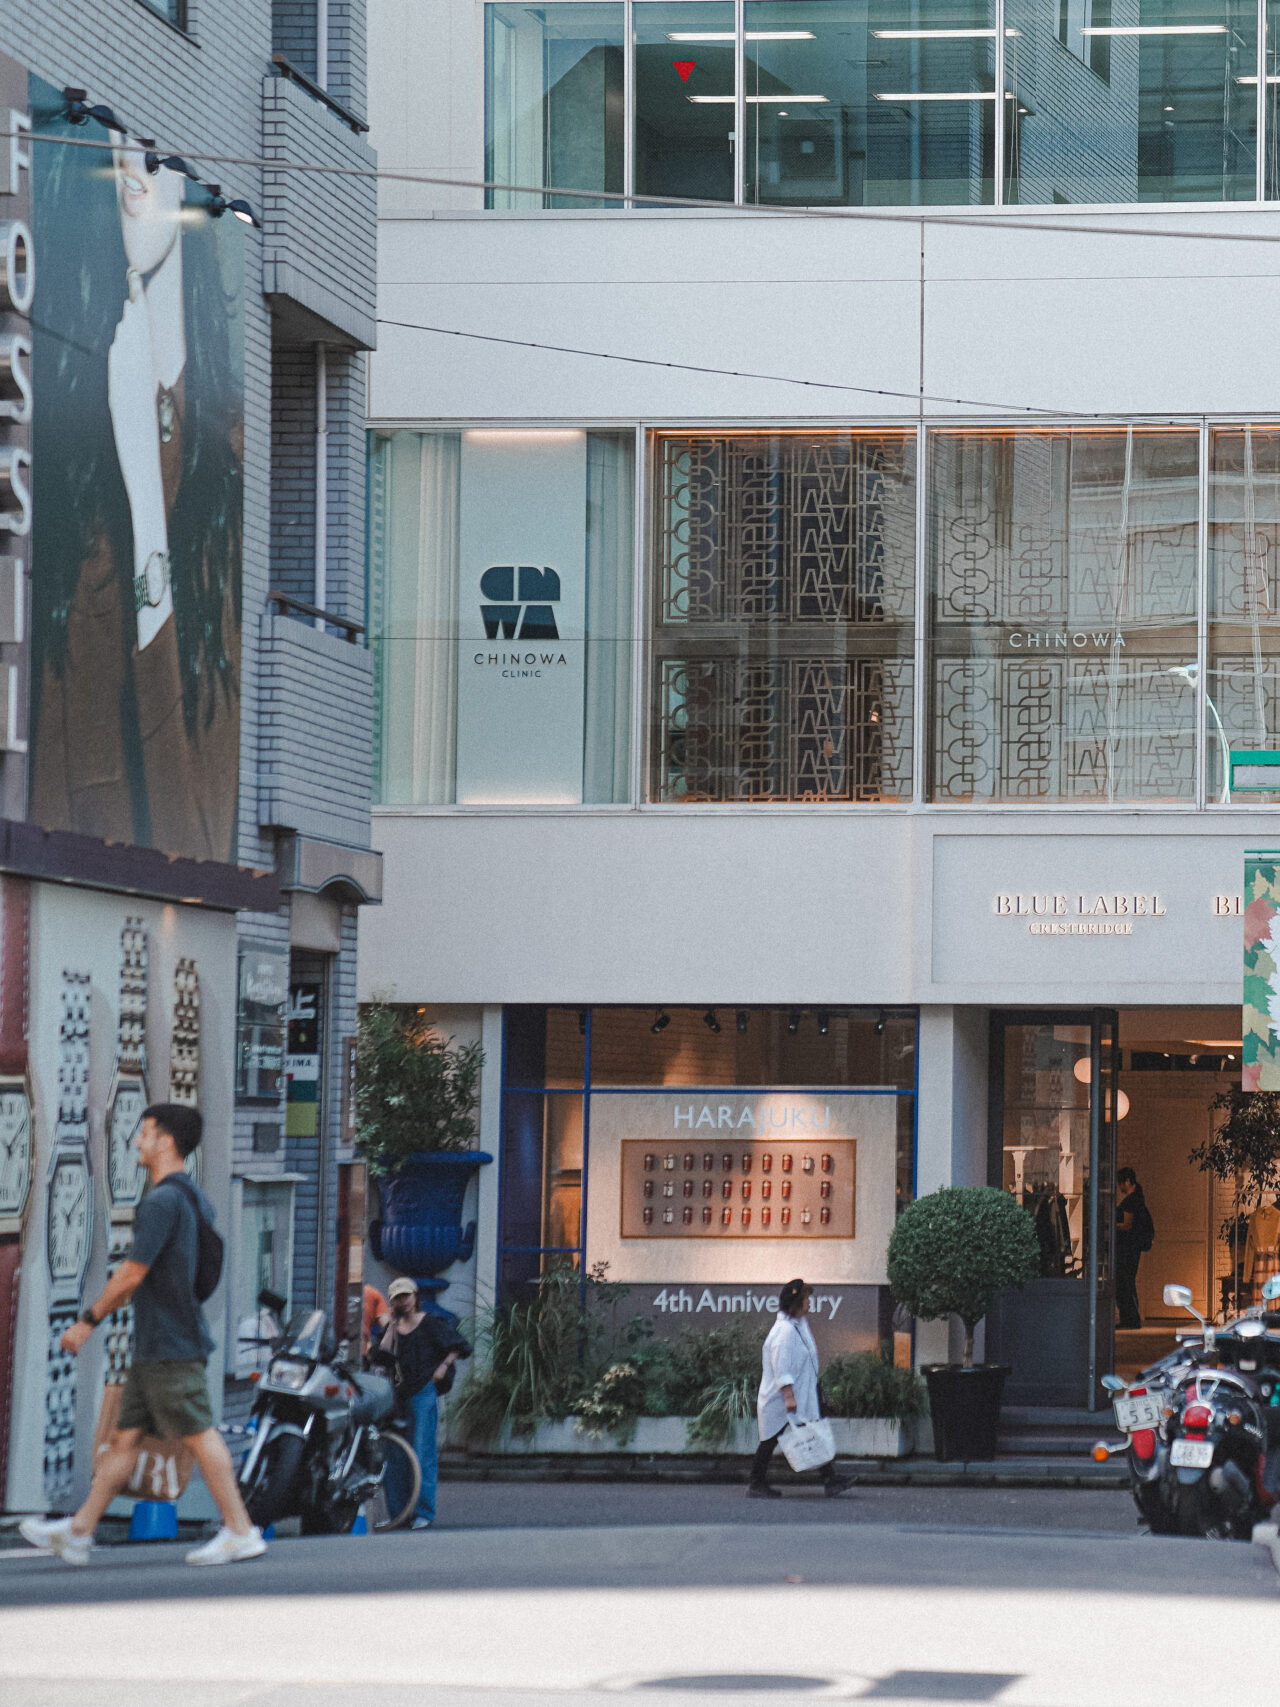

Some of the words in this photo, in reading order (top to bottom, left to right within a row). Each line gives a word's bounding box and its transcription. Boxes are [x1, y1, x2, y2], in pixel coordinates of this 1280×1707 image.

[6, 107, 35, 753] FOSSIL
[1009, 632, 1126, 648] CHINOWA
[474, 653, 567, 665] CHINOWA
[502, 670, 542, 678] CLINIC
[996, 895, 1067, 917] BLUE
[1077, 895, 1168, 917] LABEL
[1214, 896, 1244, 917] BL
[1029, 922, 1133, 935] CRESTBRIDGE
[673, 1105, 830, 1135] HARAJUKU
[653, 1288, 692, 1313] 4th
[695, 1288, 843, 1320] Anniveary
